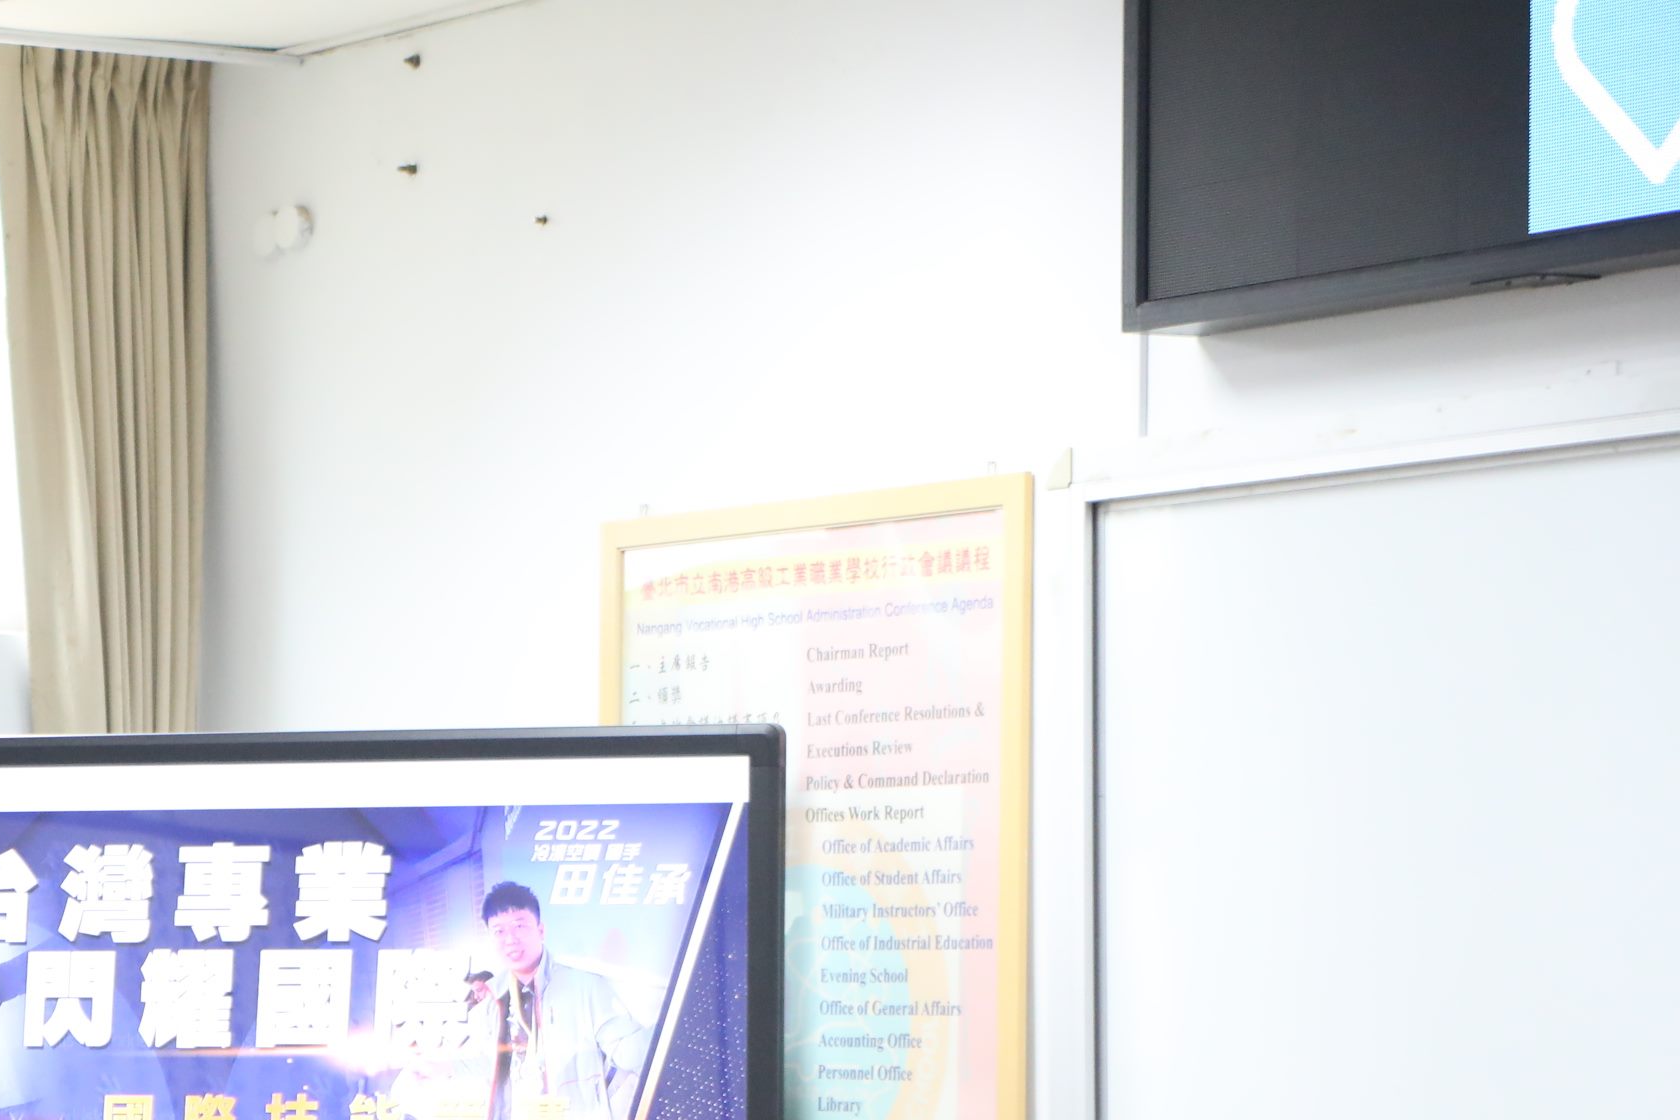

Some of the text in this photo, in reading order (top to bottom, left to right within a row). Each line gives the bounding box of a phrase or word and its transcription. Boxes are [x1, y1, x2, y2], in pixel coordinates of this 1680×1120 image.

[636, 595, 994, 639] Nangang Vocational High School Administration Conference Agenda
[807, 642, 909, 663] Chairman Report
[807, 678, 863, 697] Awarding
[807, 702, 985, 728] Last Conference Resolutions &
[807, 740, 913, 759] Executions Review
[806, 769, 989, 794] Policy & Command Declaration
[805, 804, 924, 824] Offices Work Report
[534, 820, 619, 840] 2022
[822, 835, 974, 854] Office of Academic Affairs
[549, 862, 692, 906] 田佳承
[822, 868, 962, 887] Office of Student Affairs
[823, 902, 868, 921] Military
[943, 900, 978, 917] Office
[821, 933, 993, 951] Office of Industrial Education
[821, 968, 908, 986] Evening School
[23, 948, 472, 1049] 閃耀國際
[820, 1000, 962, 1017] Office of General Affairs
[818, 1033, 922, 1052] Accounting Office
[818, 1065, 913, 1081] Personnel Office
[817, 1096, 862, 1116] Library
